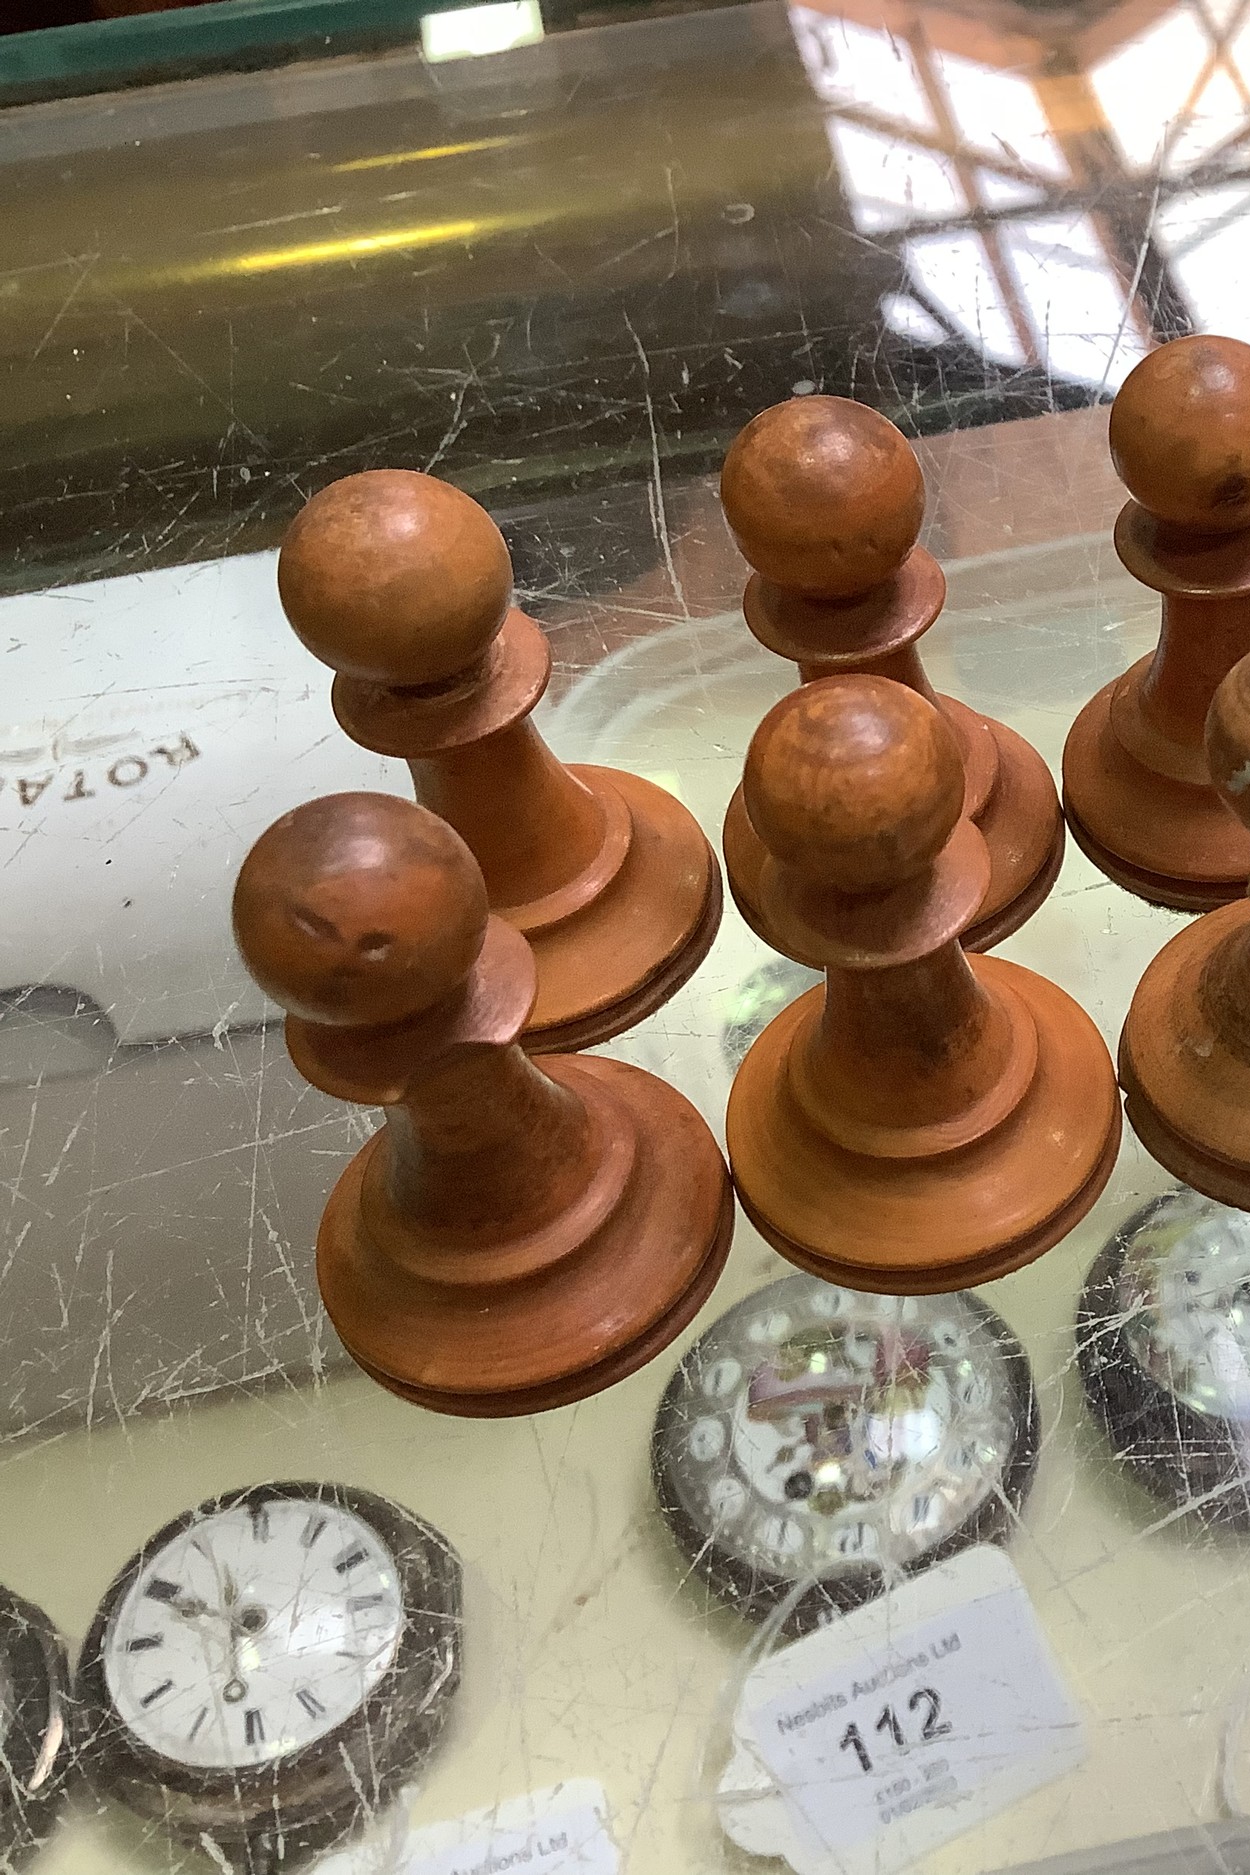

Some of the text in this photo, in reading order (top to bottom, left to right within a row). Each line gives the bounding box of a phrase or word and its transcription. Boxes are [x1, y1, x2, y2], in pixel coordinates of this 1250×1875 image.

[0, 730, 201, 807] ROTA
[930, 1632, 962, 1660] Ltd
[839, 1686, 953, 1772] 112
